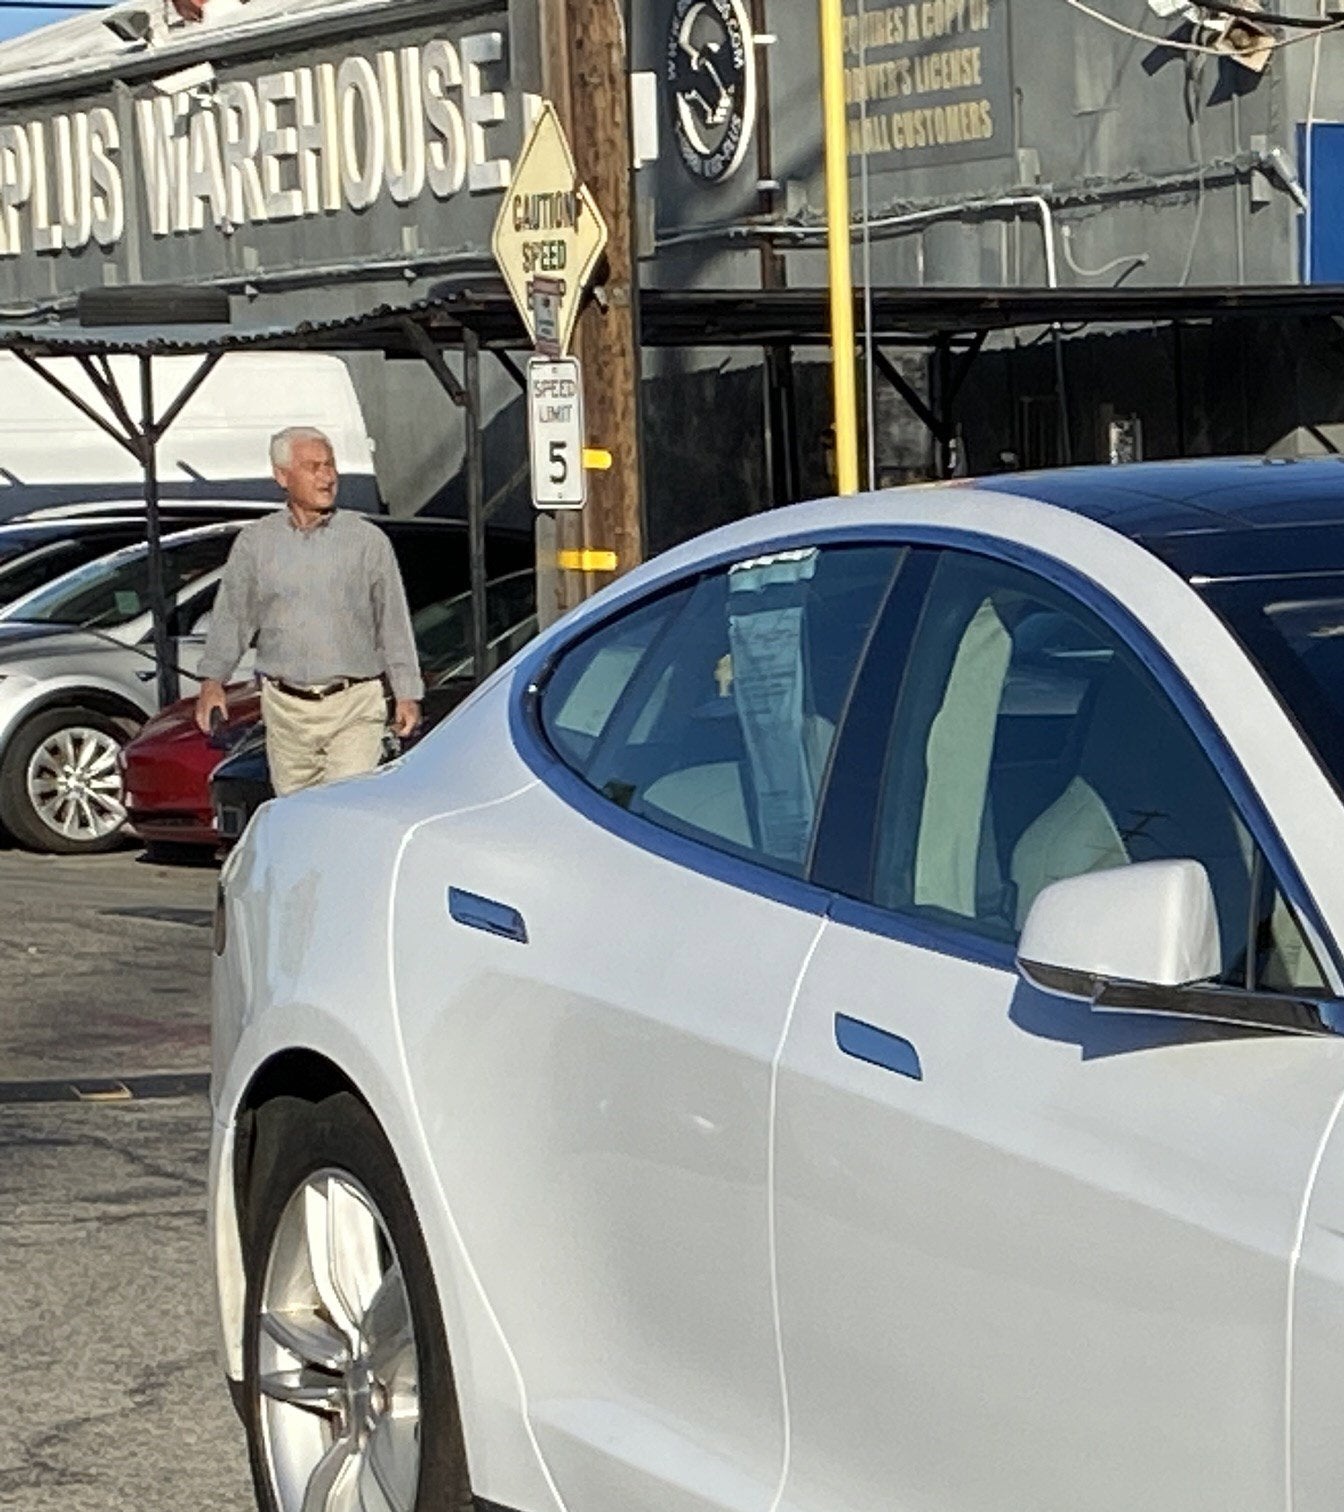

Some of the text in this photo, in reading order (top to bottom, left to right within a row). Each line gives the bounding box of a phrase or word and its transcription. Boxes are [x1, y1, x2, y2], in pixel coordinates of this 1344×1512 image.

[914, 46, 982, 93] LICENSE
[0, 108, 124, 255] PLUS
[136, 32, 511, 235] WAREHOUSE
[892, 100, 993, 150] CUSTOMERS
[512, 190, 577, 232] CAUTION
[522, 240, 567, 273] SPEED
[533, 379, 575, 398] SPEED
[539, 404, 573, 423] LIMIT
[549, 441, 567, 484] 5
